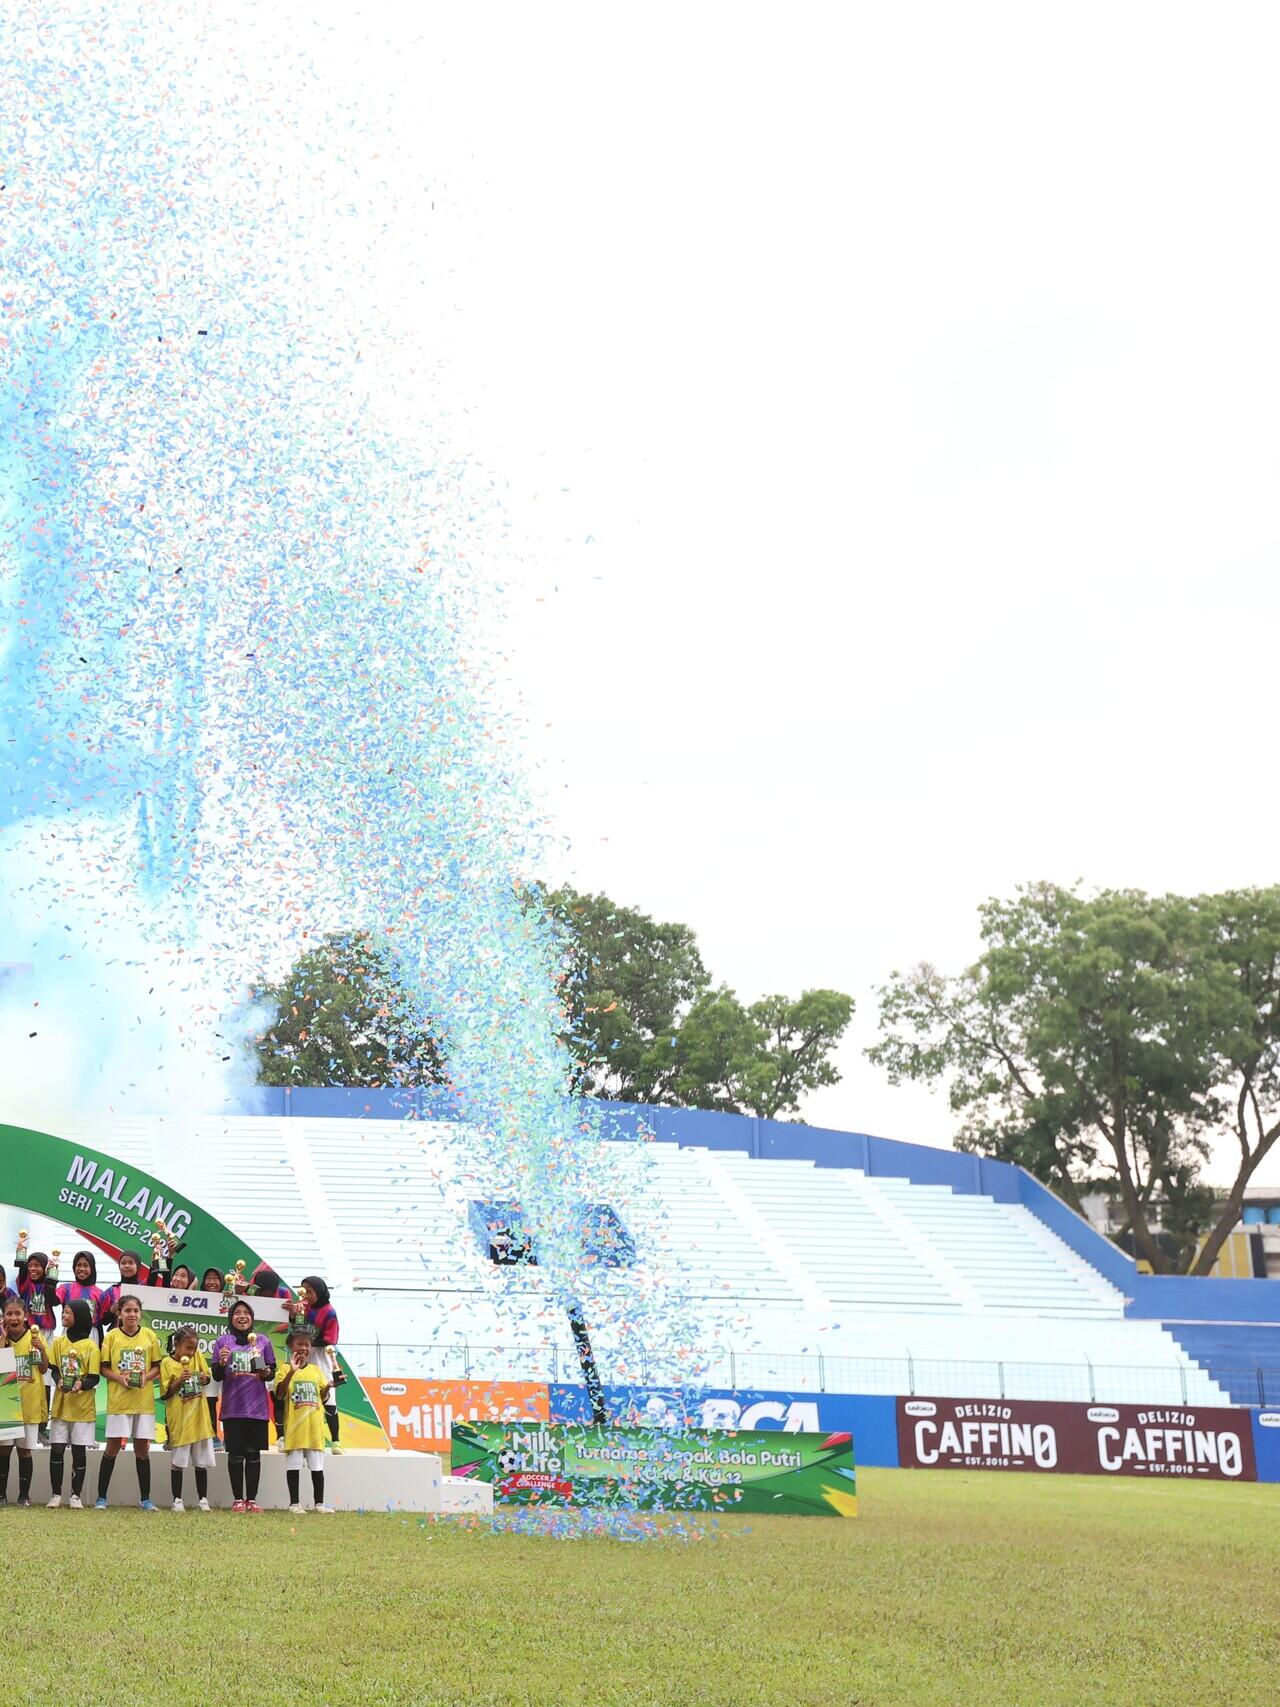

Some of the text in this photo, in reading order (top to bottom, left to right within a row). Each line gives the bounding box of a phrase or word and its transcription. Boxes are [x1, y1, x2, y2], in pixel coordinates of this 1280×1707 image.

[58, 1187, 93, 1212] SERI
[95, 1203, 103, 1217] 1
[66, 1154, 192, 1240] MALANG
[181, 1296, 208, 1310] BCA
[296, 1382, 317, 1394] Milk
[301, 1391, 318, 1402] Life
[954, 1404, 1012, 1420] DELIZIO
[1137, 1411, 1196, 1427] DELIZIO
[512, 1431, 559, 1452] Milk
[914, 1420, 1058, 1469] CAFFINO
[719, 1450, 756, 1466] Bola
[760, 1451, 801, 1468] Putri
[1097, 1426, 1243, 1477] CAFFINO
[521, 1451, 562, 1473] Life
[516, 1480, 556, 1489] CALLENGE
[697, 1467, 722, 1487] KU
[726, 1472, 743, 1484] 12
